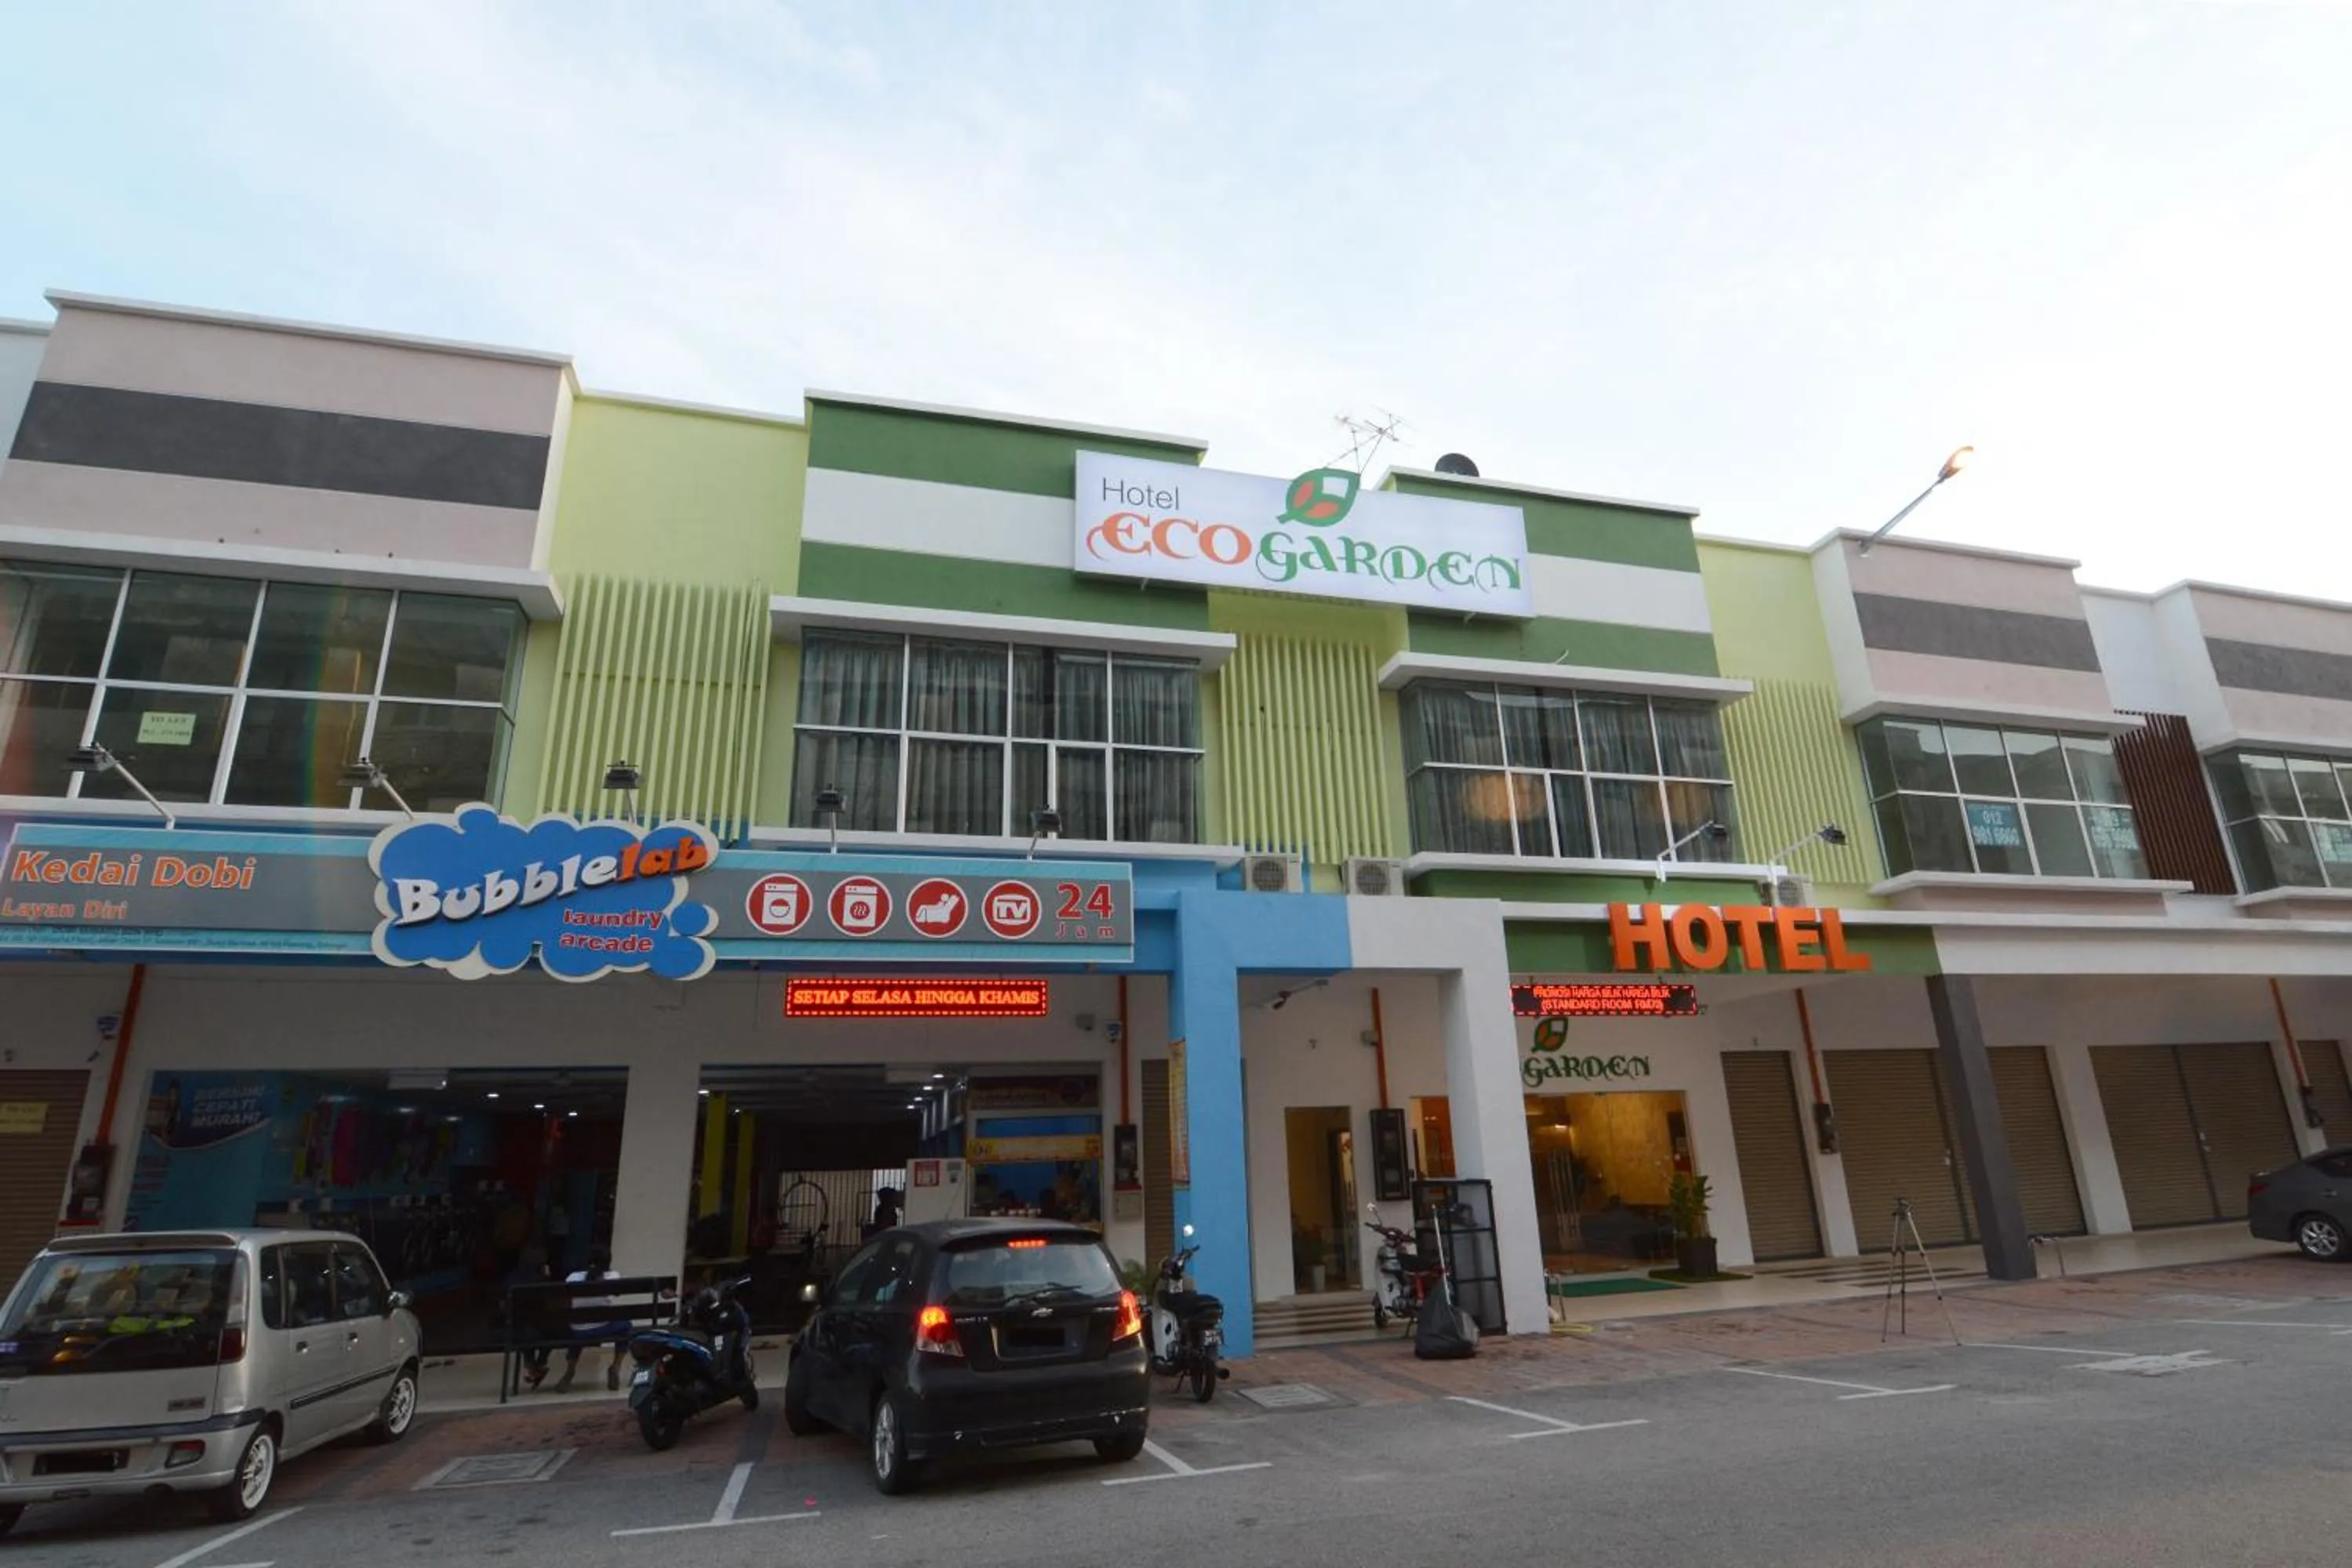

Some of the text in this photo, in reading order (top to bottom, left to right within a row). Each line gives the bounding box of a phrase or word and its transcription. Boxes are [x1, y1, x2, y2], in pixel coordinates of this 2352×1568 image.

[1102, 477, 1179, 510] Hotel
[1086, 512, 1522, 593] ECO GARDEN
[11, 851, 256, 890] Kedai Dobi
[394, 837, 710, 926] Bubblelab
[1, 898, 129, 921] Layan Diri
[1056, 882, 1114, 920] 24
[564, 908, 664, 930] laundry
[560, 931, 654, 953] arcade
[1606, 902, 1872, 971] HOTEL
[793, 989, 1040, 1005] SETIAP SELASA HINGGA KHAMIS
[1522, 1054, 1650, 1087] GARDEN
